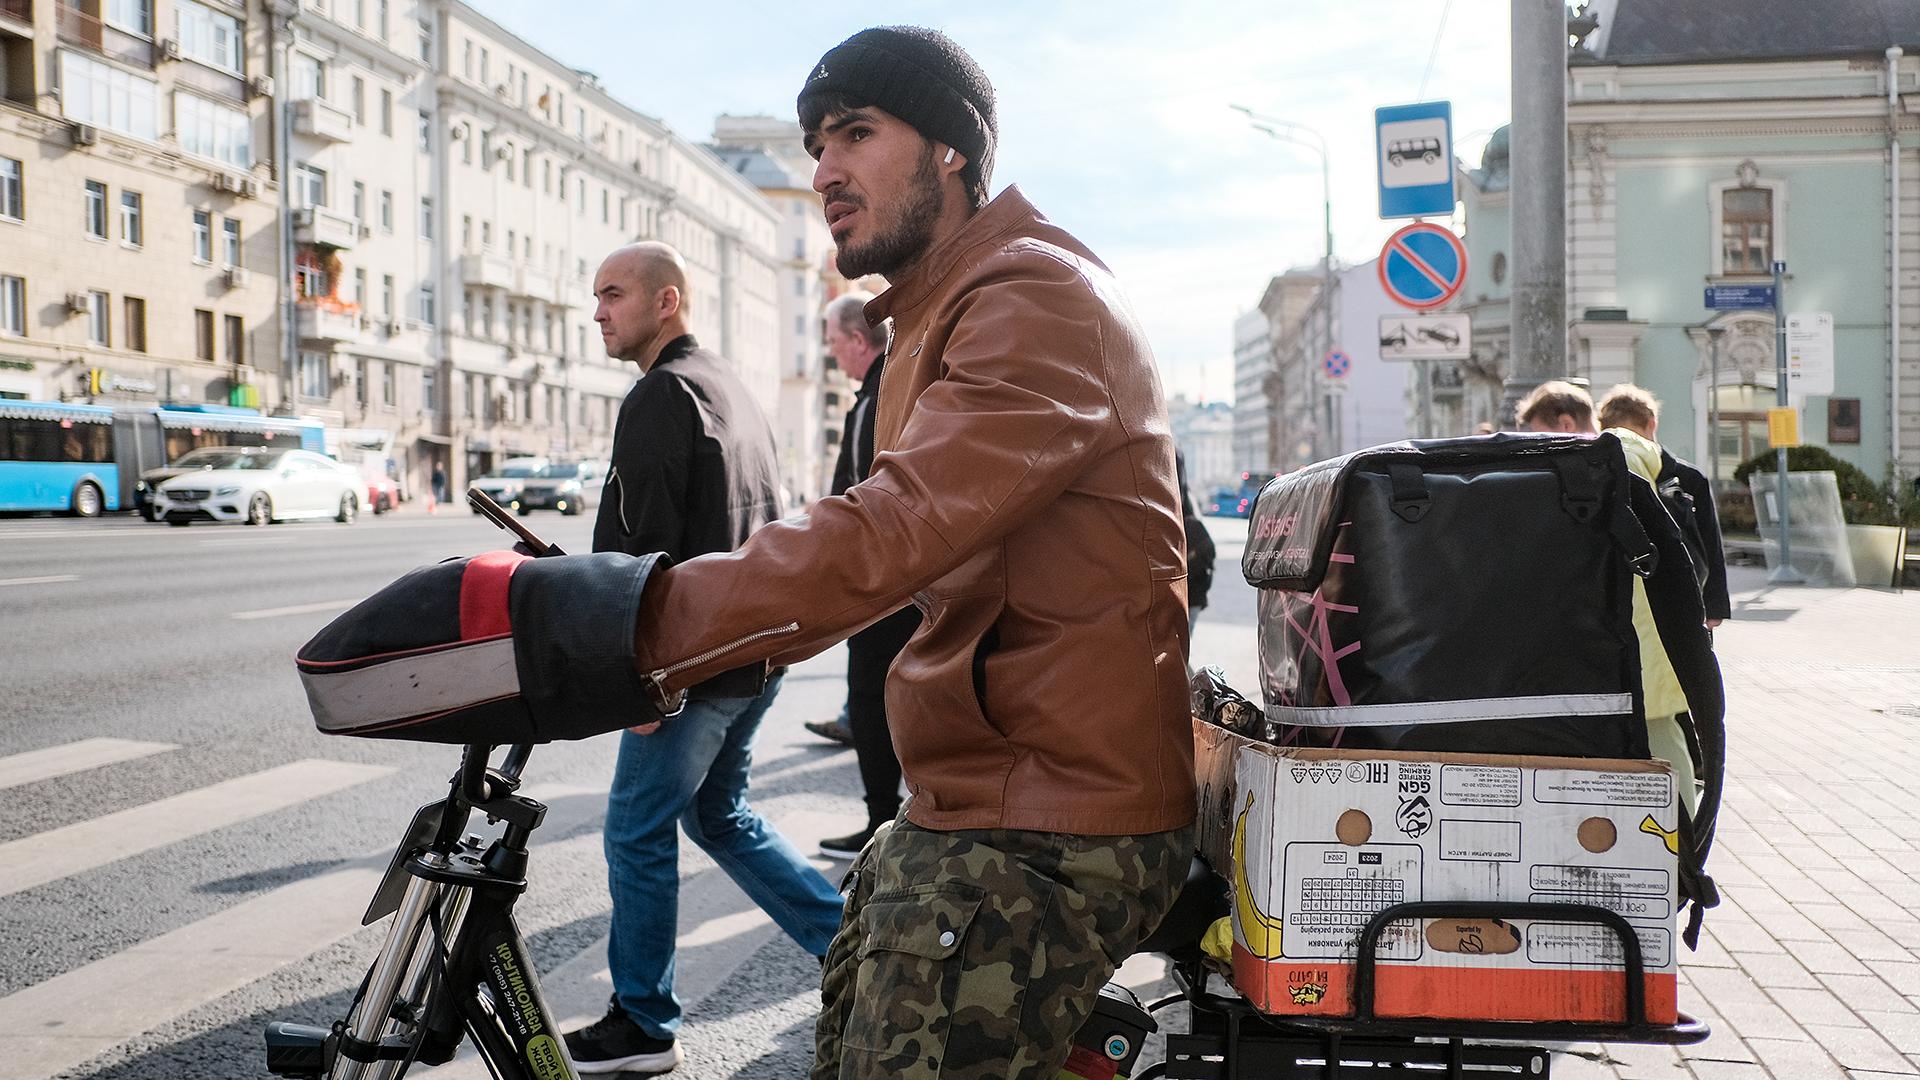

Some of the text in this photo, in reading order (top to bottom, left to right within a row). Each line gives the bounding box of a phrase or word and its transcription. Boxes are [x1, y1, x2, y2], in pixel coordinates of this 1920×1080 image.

[1398, 781, 1431, 793] GGN
[1308, 939, 1342, 947] упаковки
[1376, 940, 1394, 950] Дата
[488, 954, 498, 965] +7
[503, 987, 527, 1036] 247-21-18
[495, 942, 543, 1035] КРУТИКОЛЁСА
[530, 1046, 549, 1079] ЖДЁТ
[540, 1039, 559, 1074] ТВОЙ
